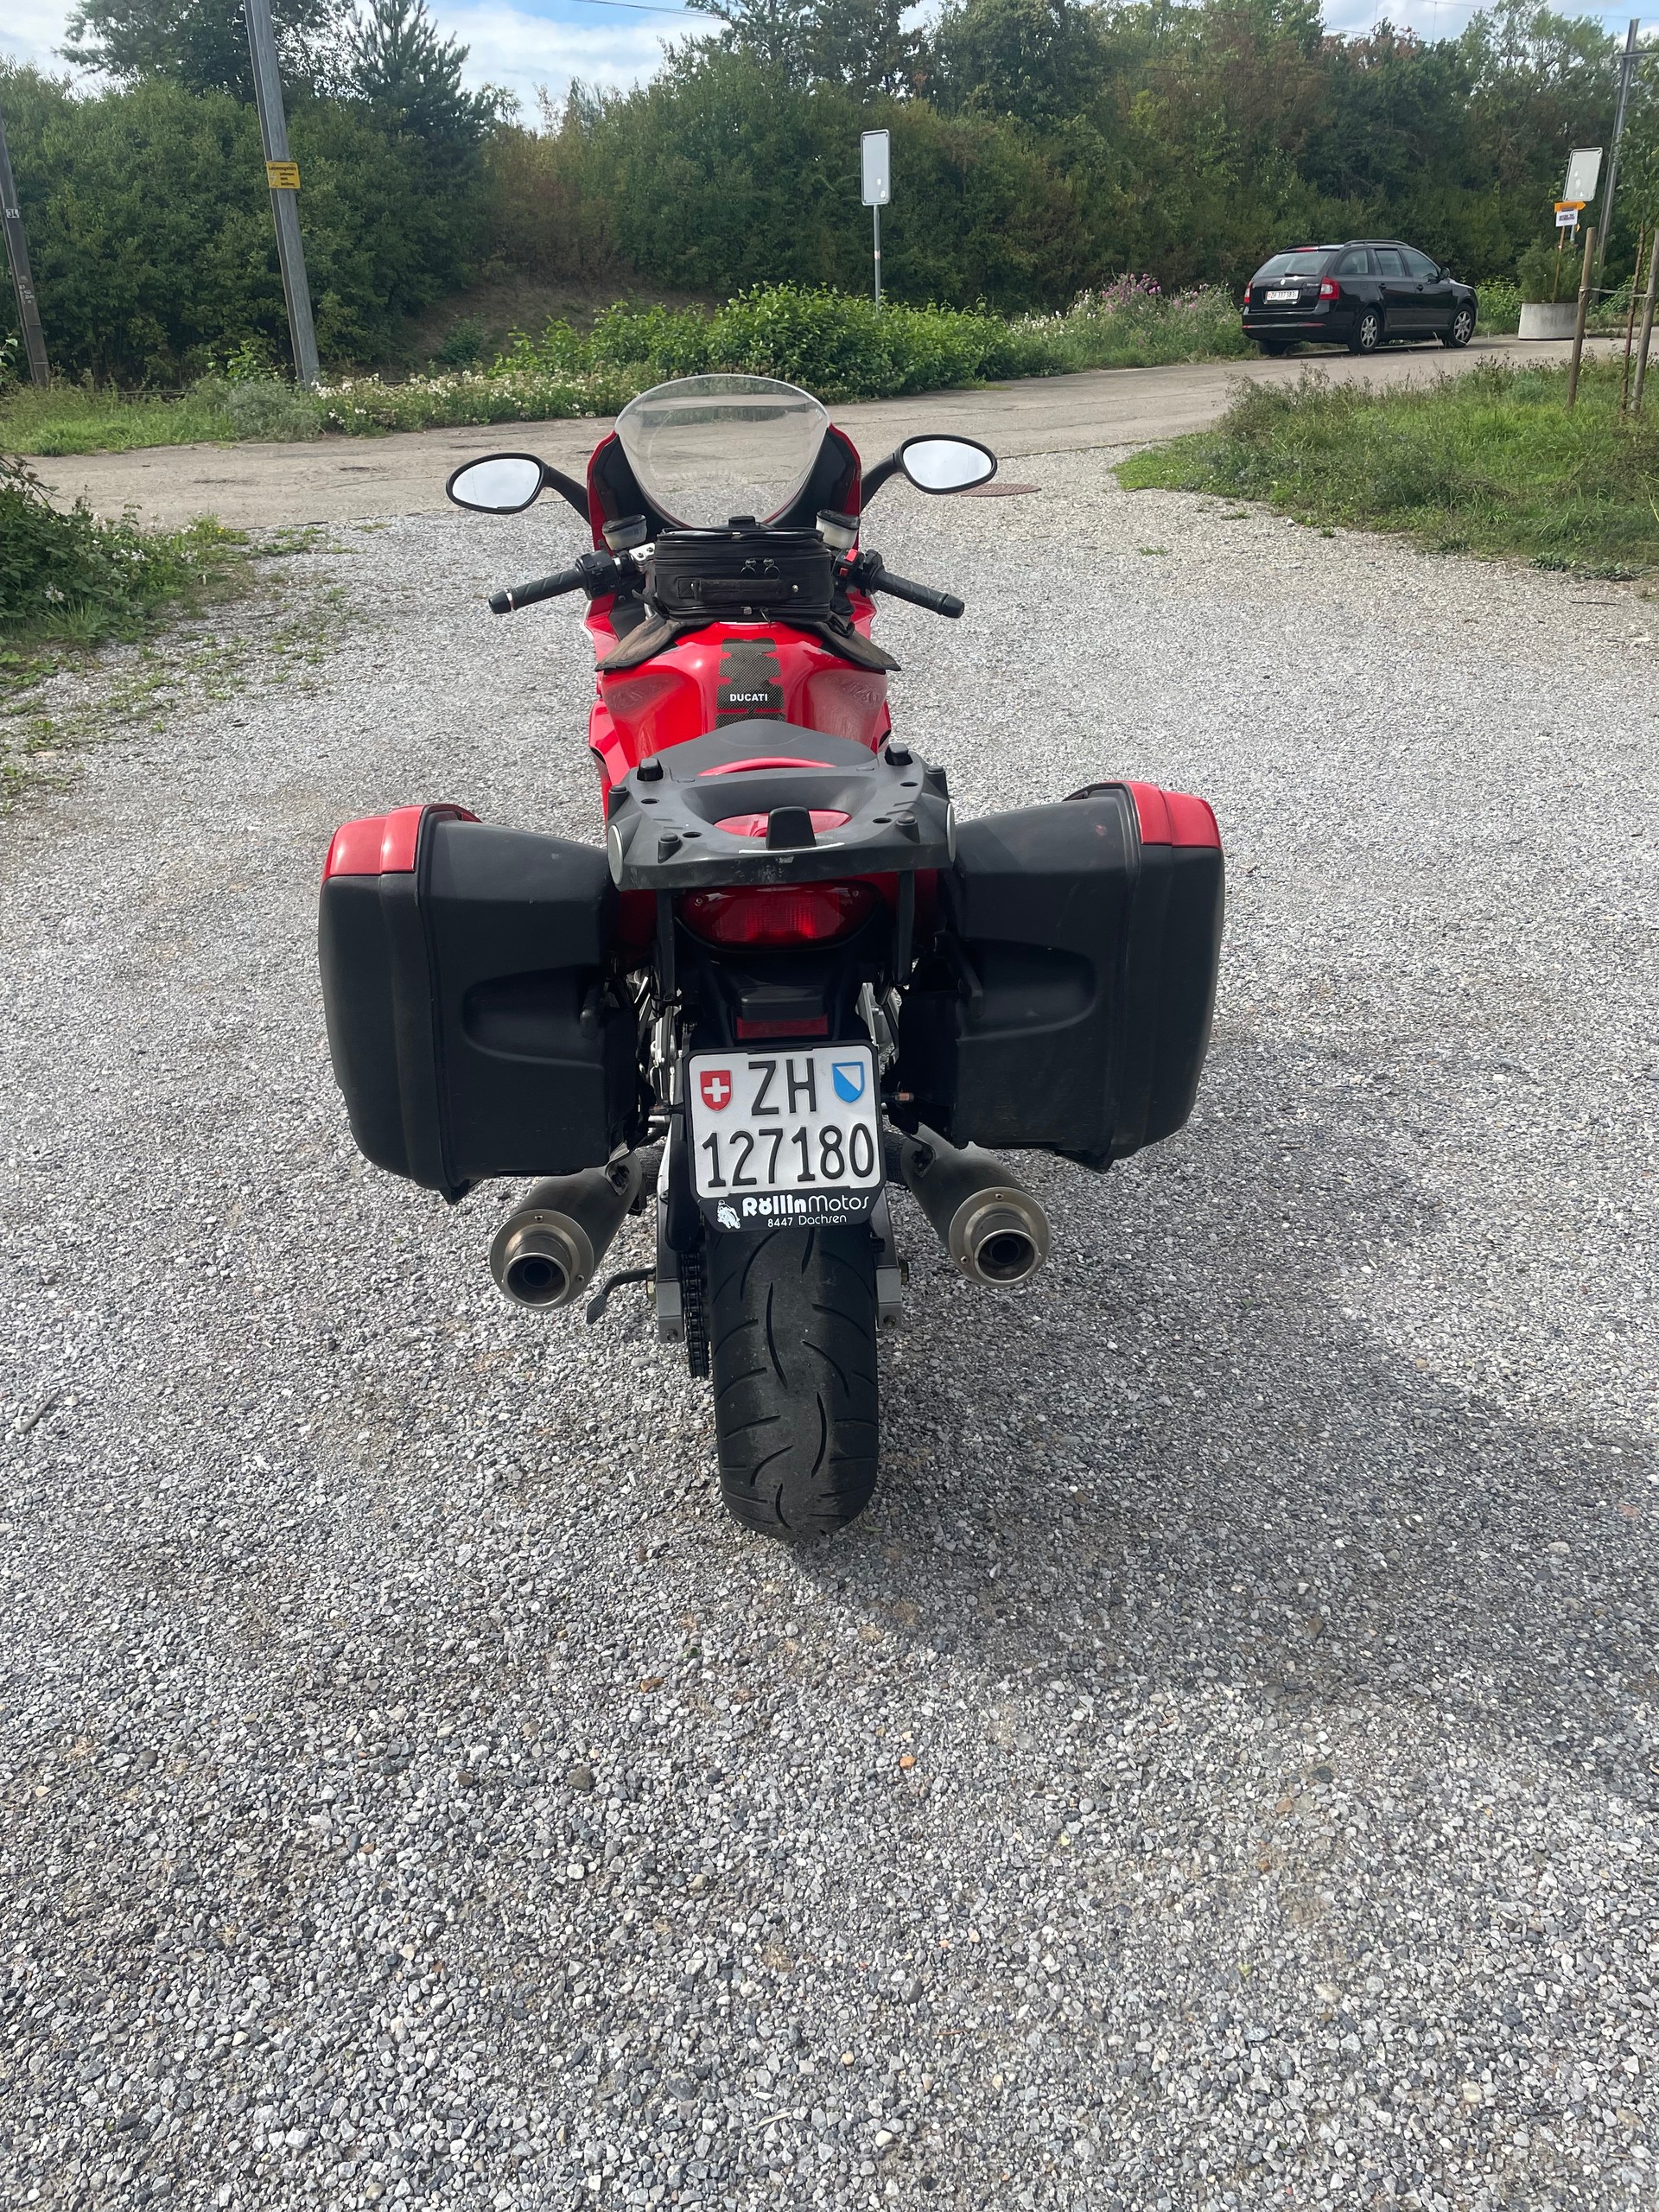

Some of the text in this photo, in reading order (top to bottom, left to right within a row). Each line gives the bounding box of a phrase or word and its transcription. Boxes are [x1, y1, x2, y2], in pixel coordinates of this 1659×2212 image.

[730, 693, 768, 702] DUCATI
[748, 1058, 817, 1116] ZH
[702, 1122, 874, 1188] 127180
[767, 1214, 847, 1228] 8447 Dachsen
